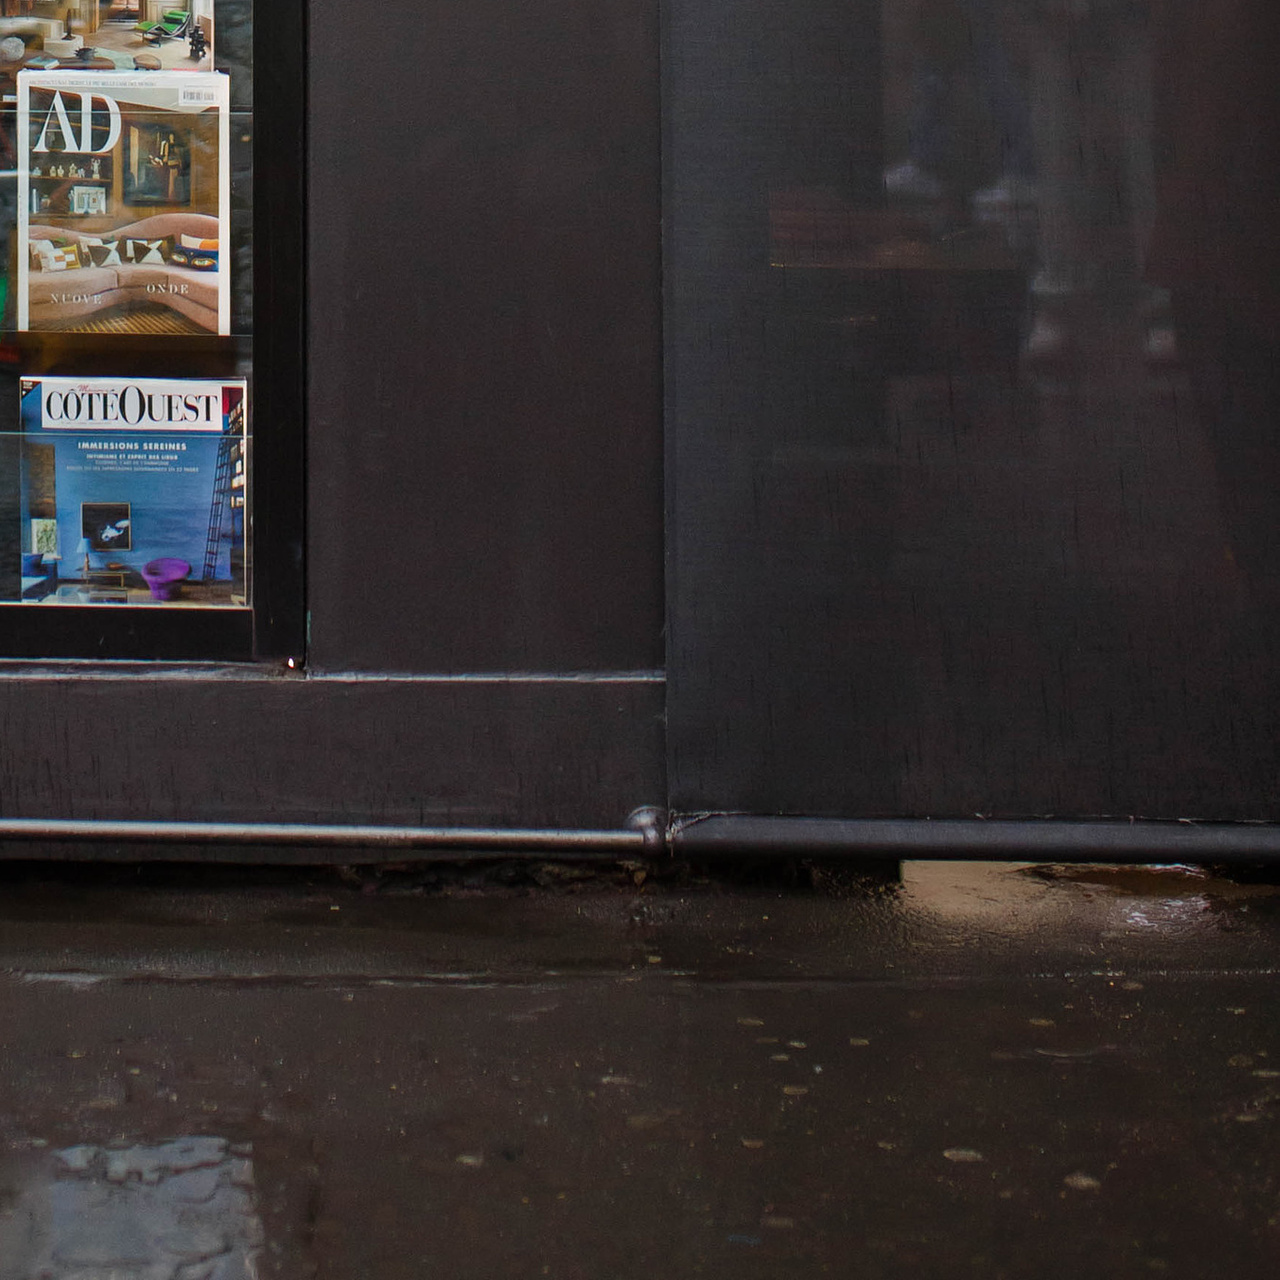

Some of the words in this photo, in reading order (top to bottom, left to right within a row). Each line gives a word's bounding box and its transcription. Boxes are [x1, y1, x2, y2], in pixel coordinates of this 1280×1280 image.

[32, 89, 122, 153] AD
[146, 283, 189, 294] ONDE
[50, 293, 102, 305] NUOVE
[78, 442, 139, 450] IMMERSIONS
[143, 442, 187, 451] SEREINES
